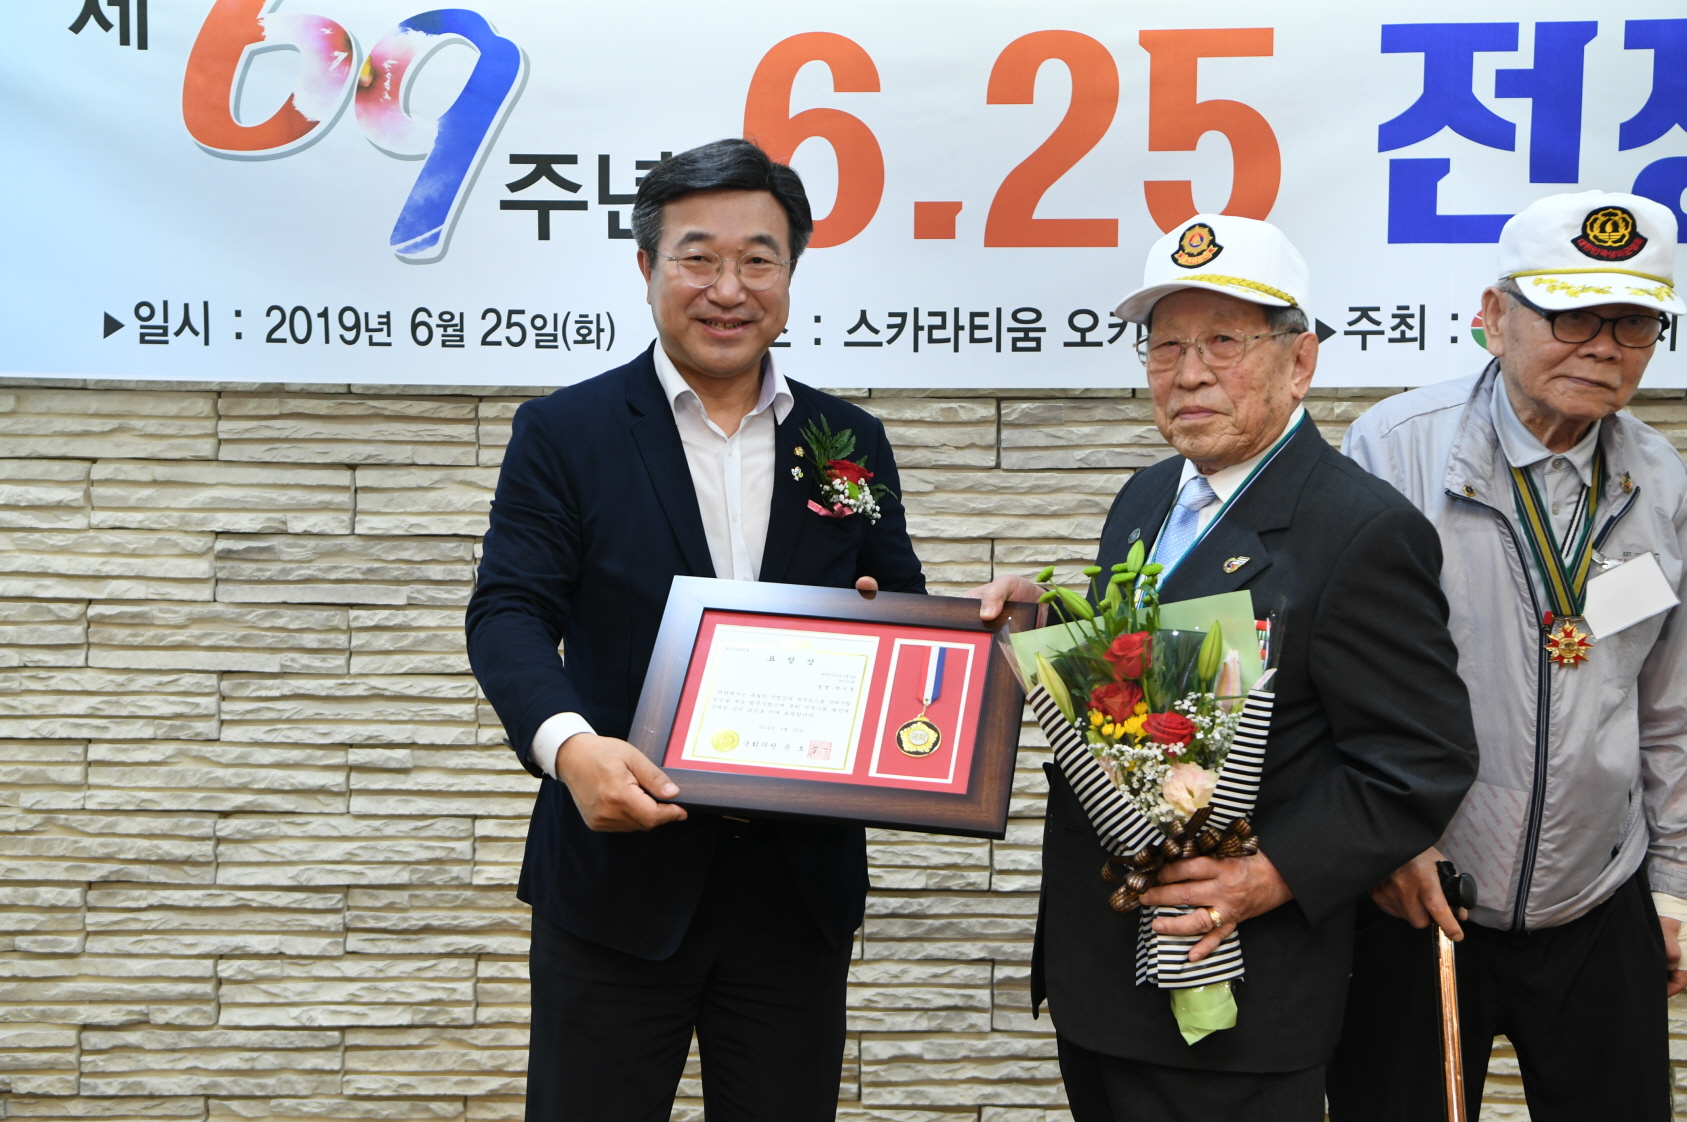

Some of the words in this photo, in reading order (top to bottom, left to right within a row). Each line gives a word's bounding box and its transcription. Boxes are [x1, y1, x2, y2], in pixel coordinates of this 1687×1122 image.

[182, 0, 530, 264] 69
[742, 27, 1282, 249] 6.25
[133, 299, 210, 347] 일시
[265, 304, 393, 347] 2019년
[410, 306, 465, 349] 6월
[480, 307, 616, 352] 25일(화)
[843, 306, 1047, 353] 스카라티움
[1343, 303, 1427, 351] 주최
